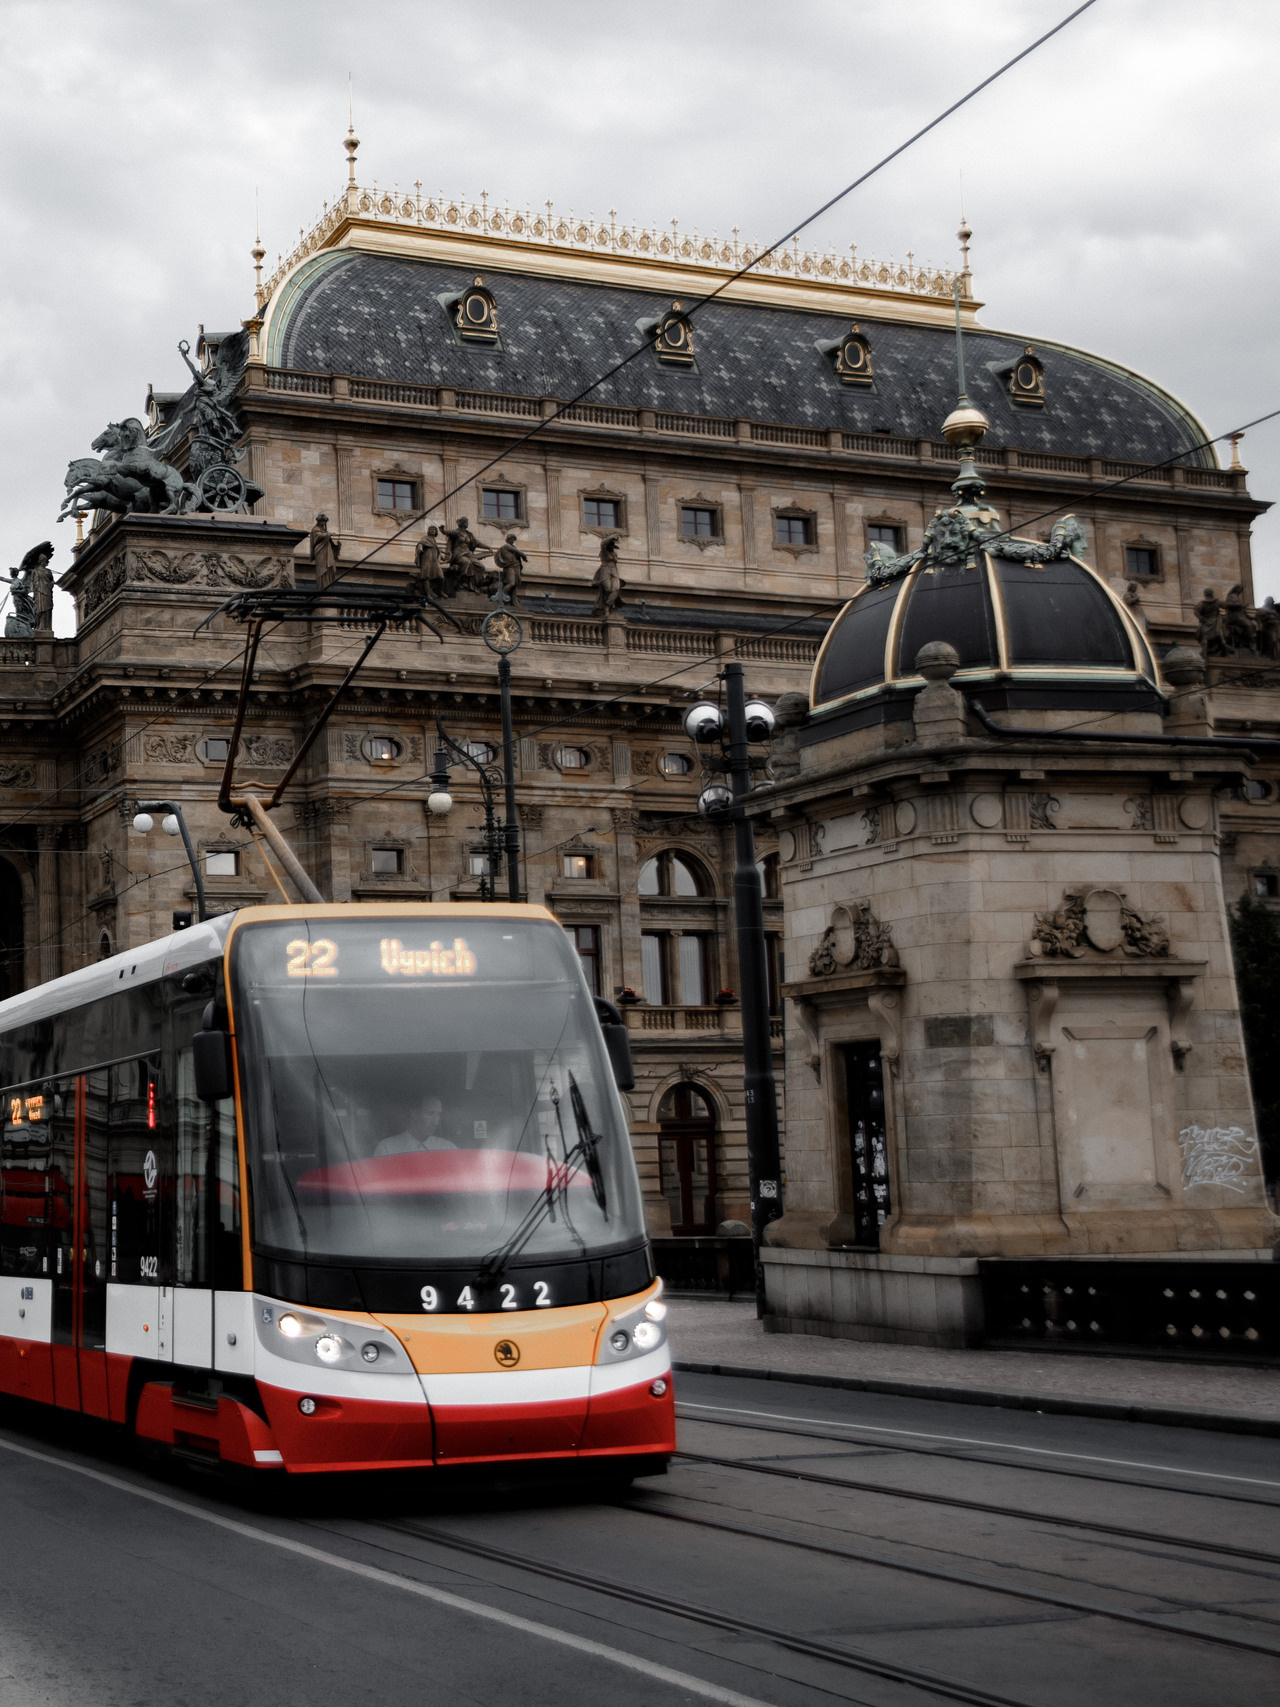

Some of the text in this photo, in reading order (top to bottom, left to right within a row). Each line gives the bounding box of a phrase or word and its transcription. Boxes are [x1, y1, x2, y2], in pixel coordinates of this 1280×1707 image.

[286, 938, 338, 977] 22
[11, 1097, 23, 1125] 22
[140, 1256, 158, 1277] 9422
